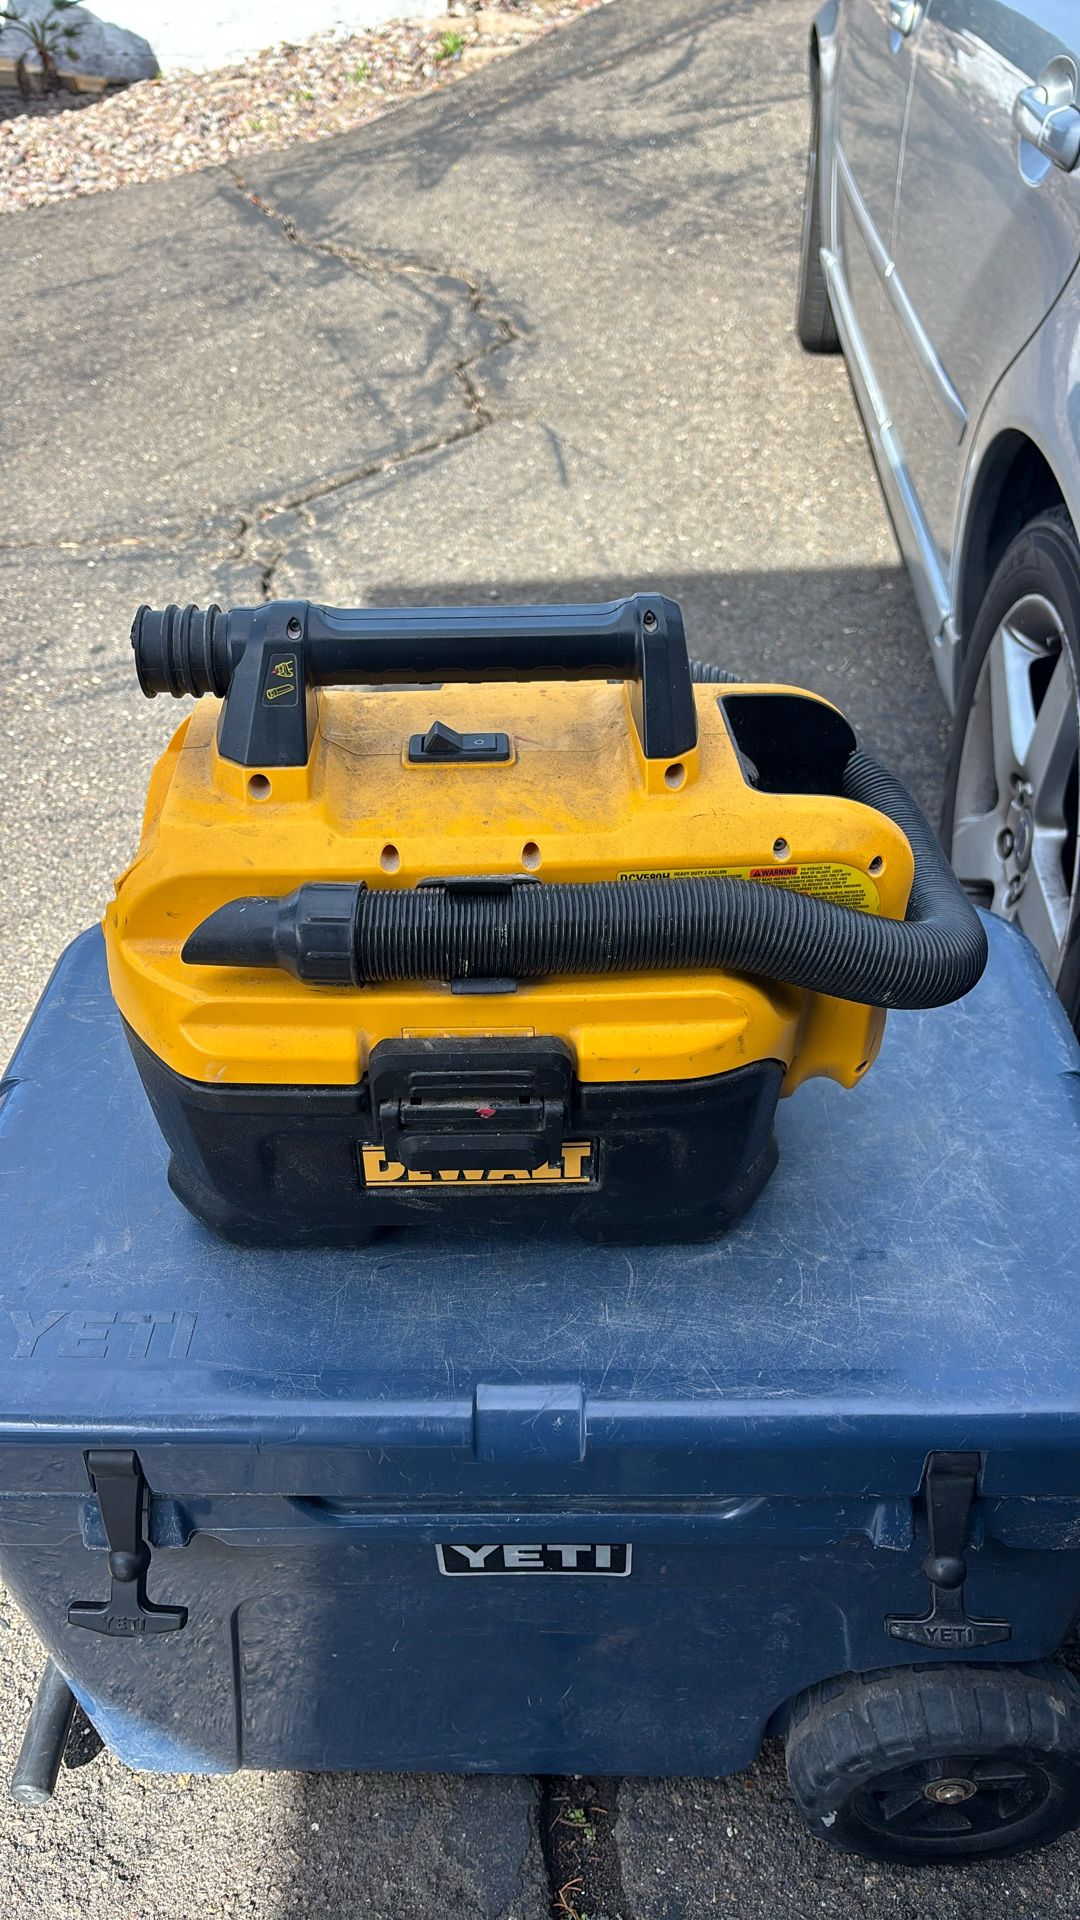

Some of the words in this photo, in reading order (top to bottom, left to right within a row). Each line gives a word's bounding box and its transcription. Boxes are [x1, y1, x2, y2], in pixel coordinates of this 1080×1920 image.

[761, 868, 797, 877] WARNING
[10, 1310, 199, 1359] YETI
[449, 1544, 611, 1568] YETI
[104, 1616, 146, 1632] YETI
[924, 1626, 974, 1642] YETI
